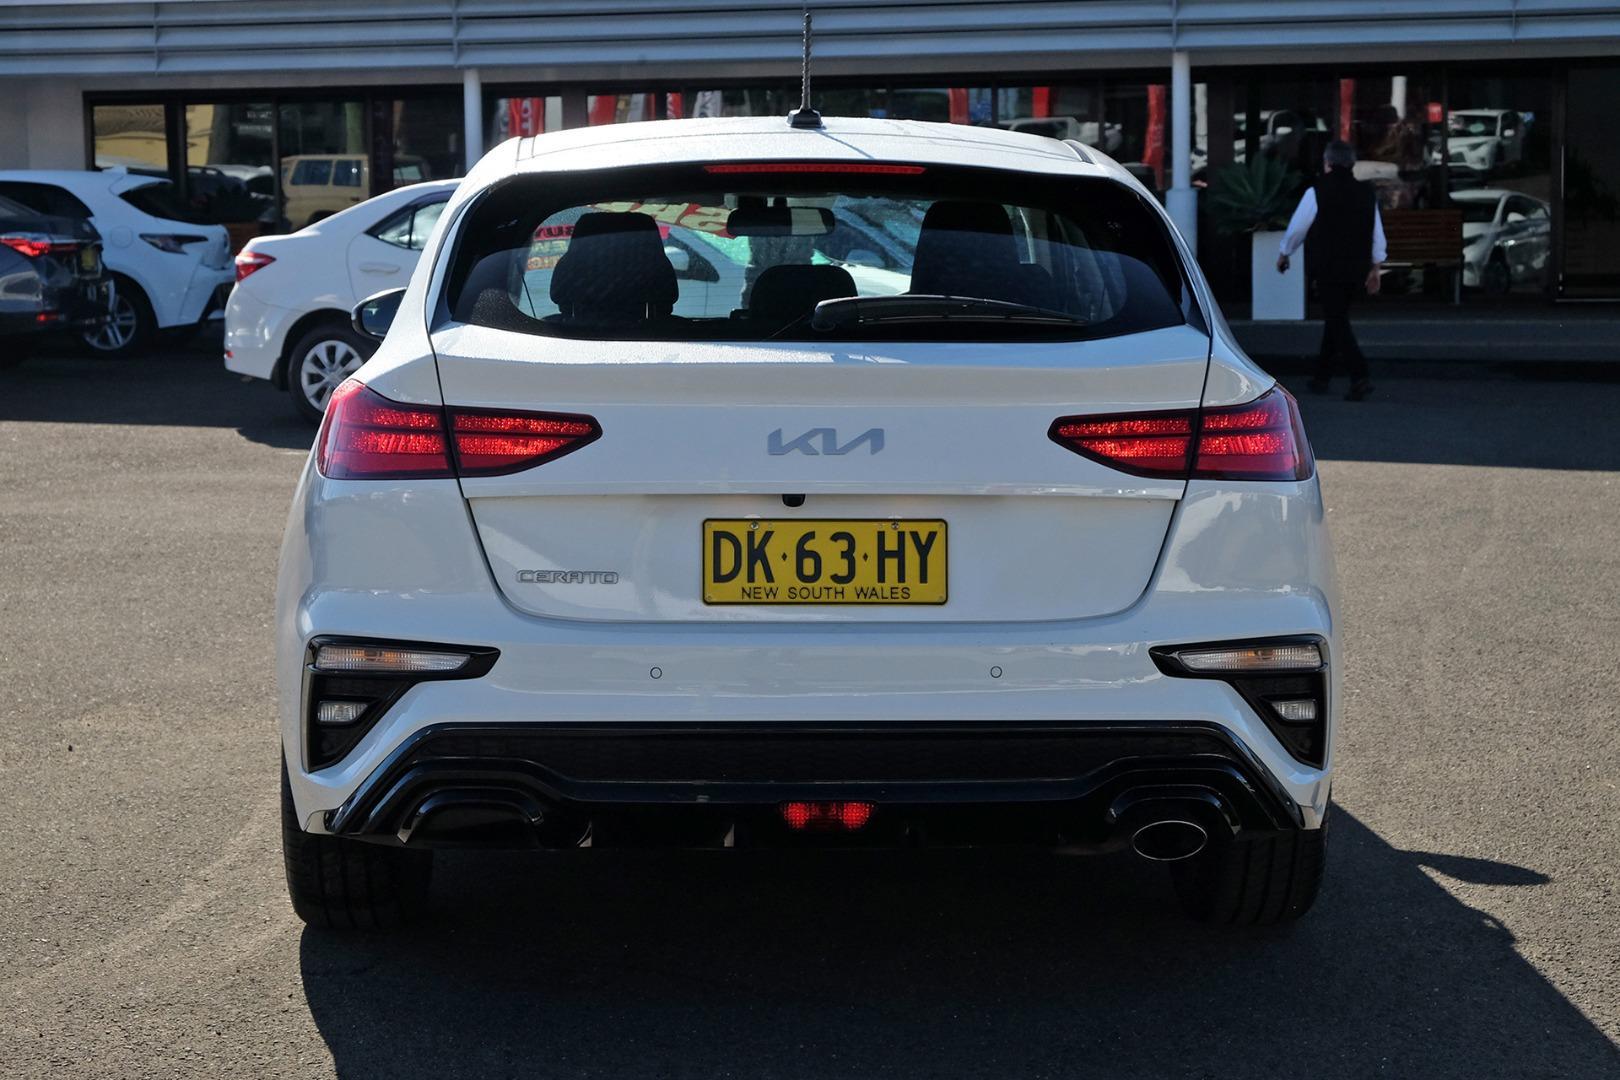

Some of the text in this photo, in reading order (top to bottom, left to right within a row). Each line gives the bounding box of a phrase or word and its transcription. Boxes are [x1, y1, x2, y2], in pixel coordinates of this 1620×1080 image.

[768, 428, 884, 456] KIA
[516, 569, 619, 584] CERATO
[741, 586, 911, 600] NEW SOUTH WALES
